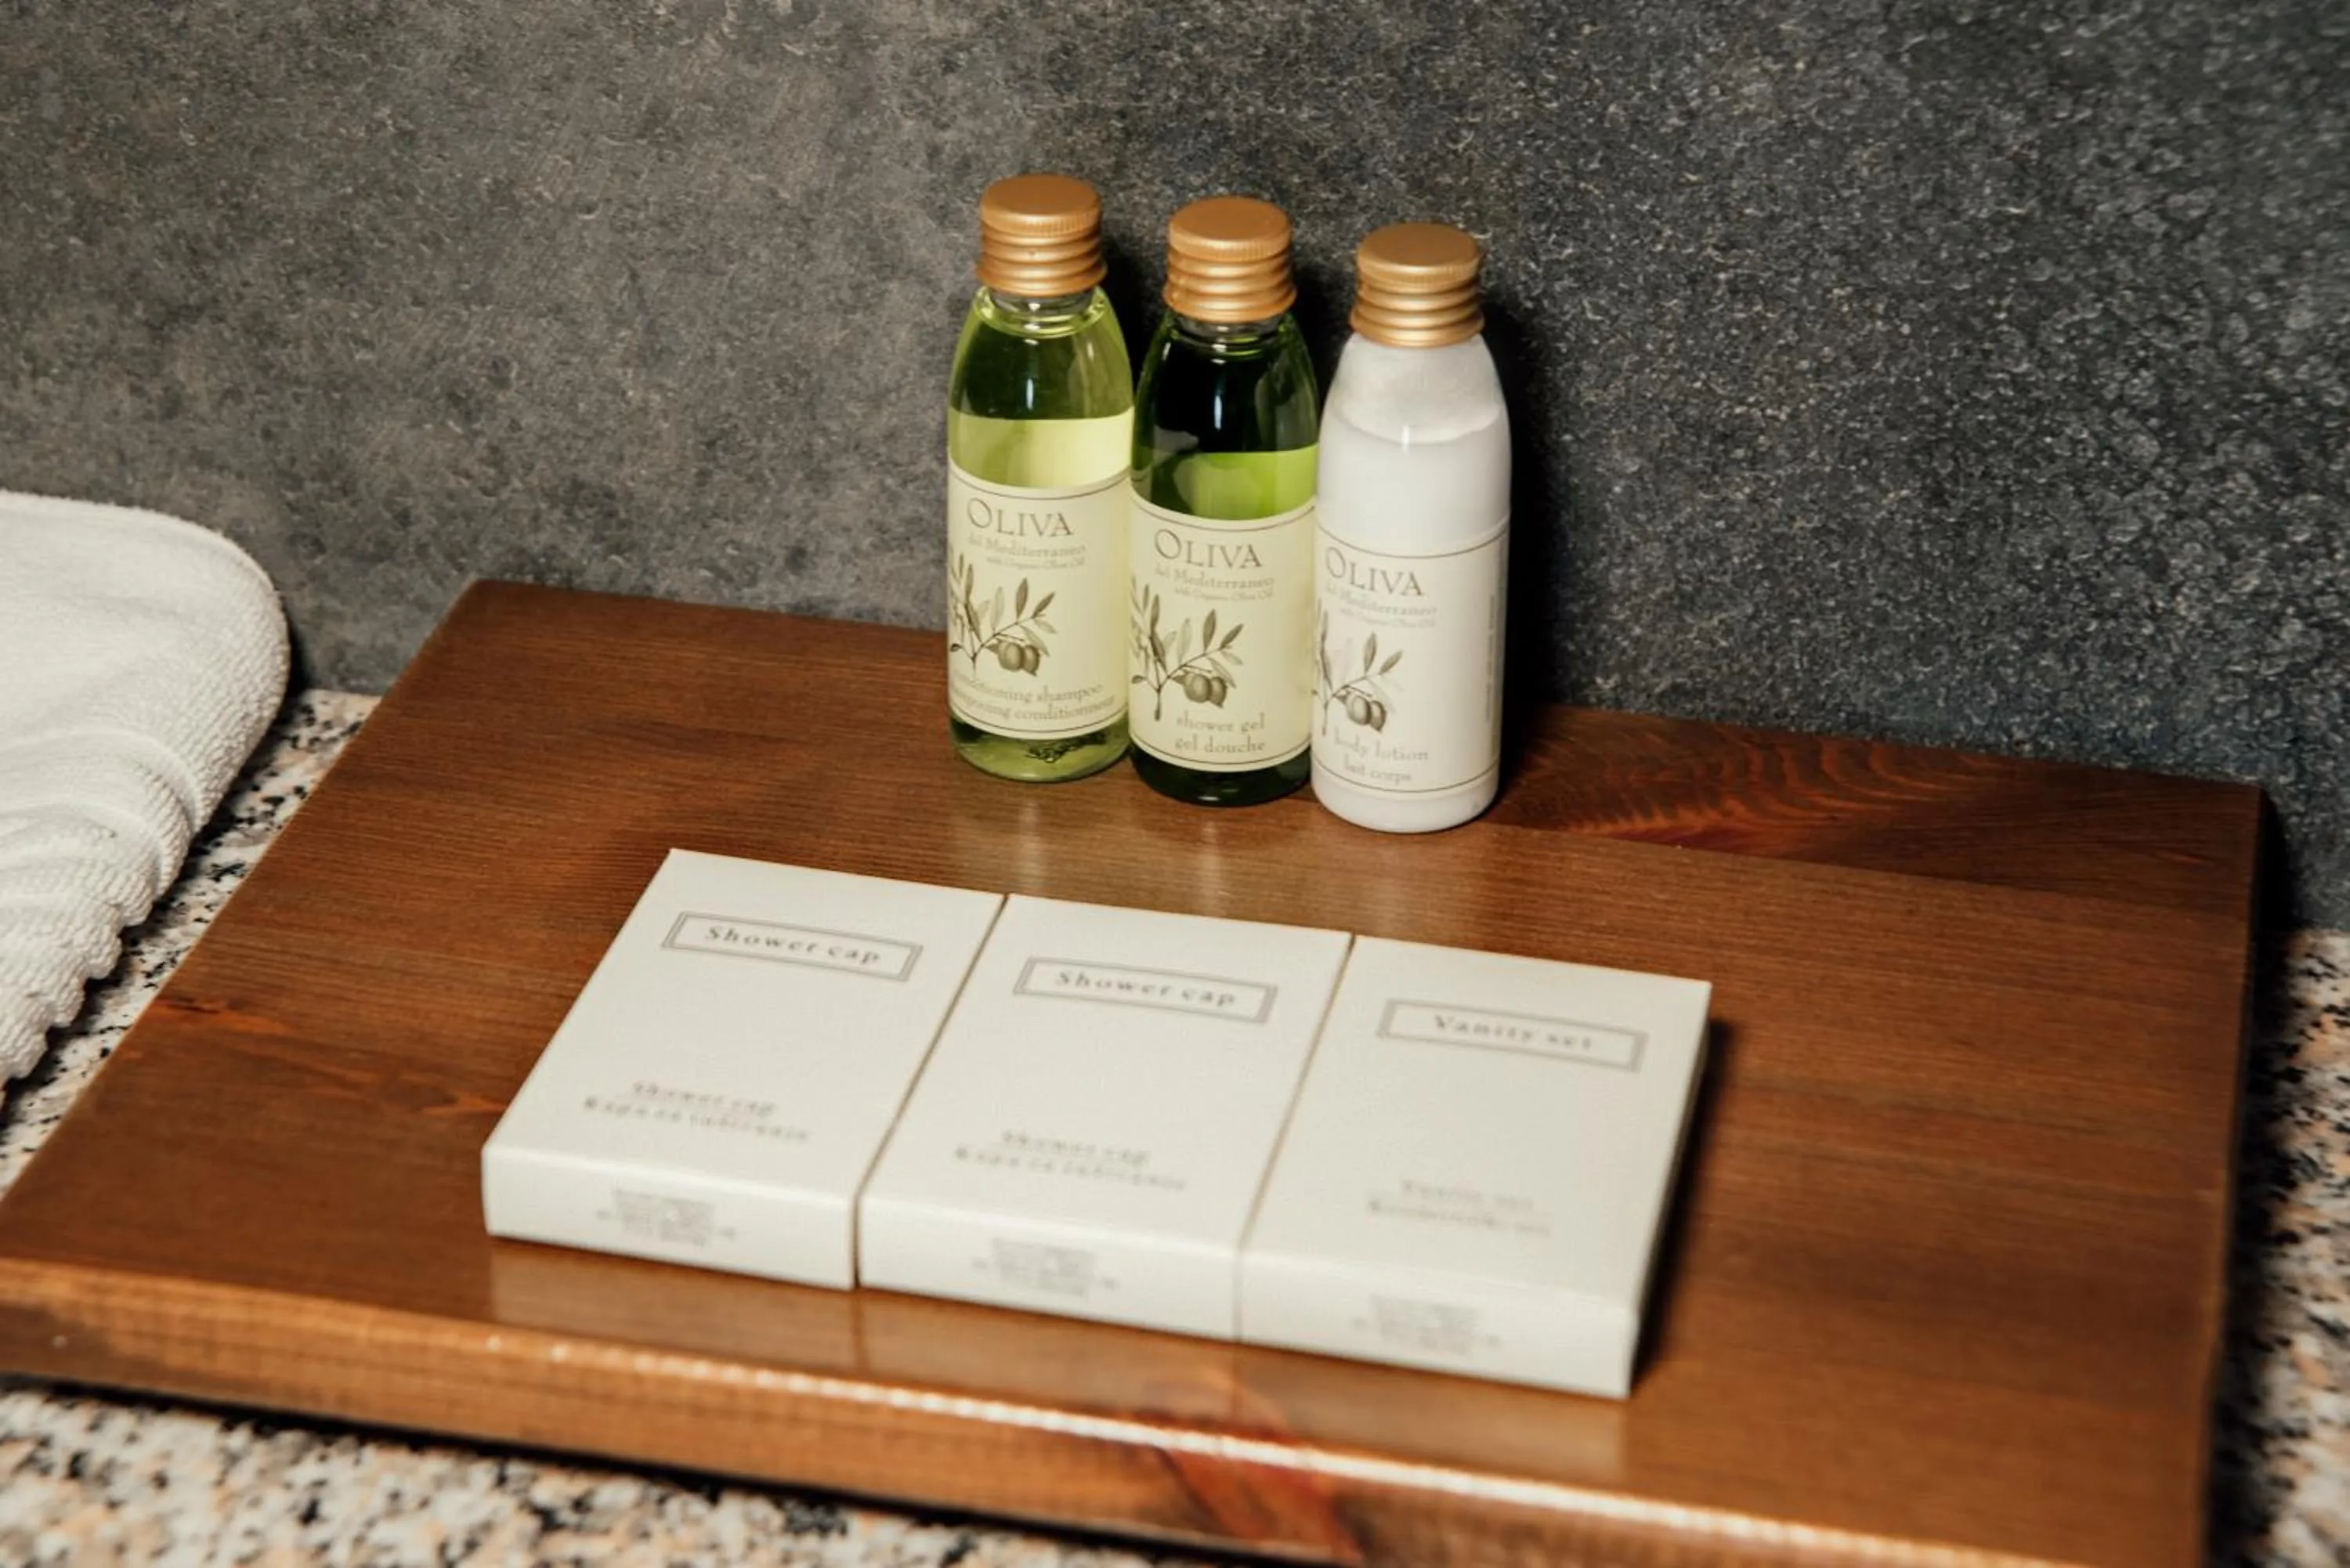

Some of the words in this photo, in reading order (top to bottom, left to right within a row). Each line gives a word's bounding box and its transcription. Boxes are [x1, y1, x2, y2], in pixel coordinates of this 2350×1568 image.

[967, 497, 1074, 537] OLIVA
[1155, 529, 1262, 569] OLIVA
[1325, 546, 1425, 596] OLIVA
[1176, 710, 1234, 732] shower
[1241, 710, 1265, 735] gel
[1175, 735, 1198, 753] gel
[1204, 735, 1266, 753] douche
[706, 926, 819, 953] Shower
[826, 945, 882, 966] cap
[1057, 970, 1173, 997] Shower
[1181, 988, 1236, 1008] cap
[1434, 1013, 1539, 1043] Vanity
[1546, 1033, 1593, 1052] set
